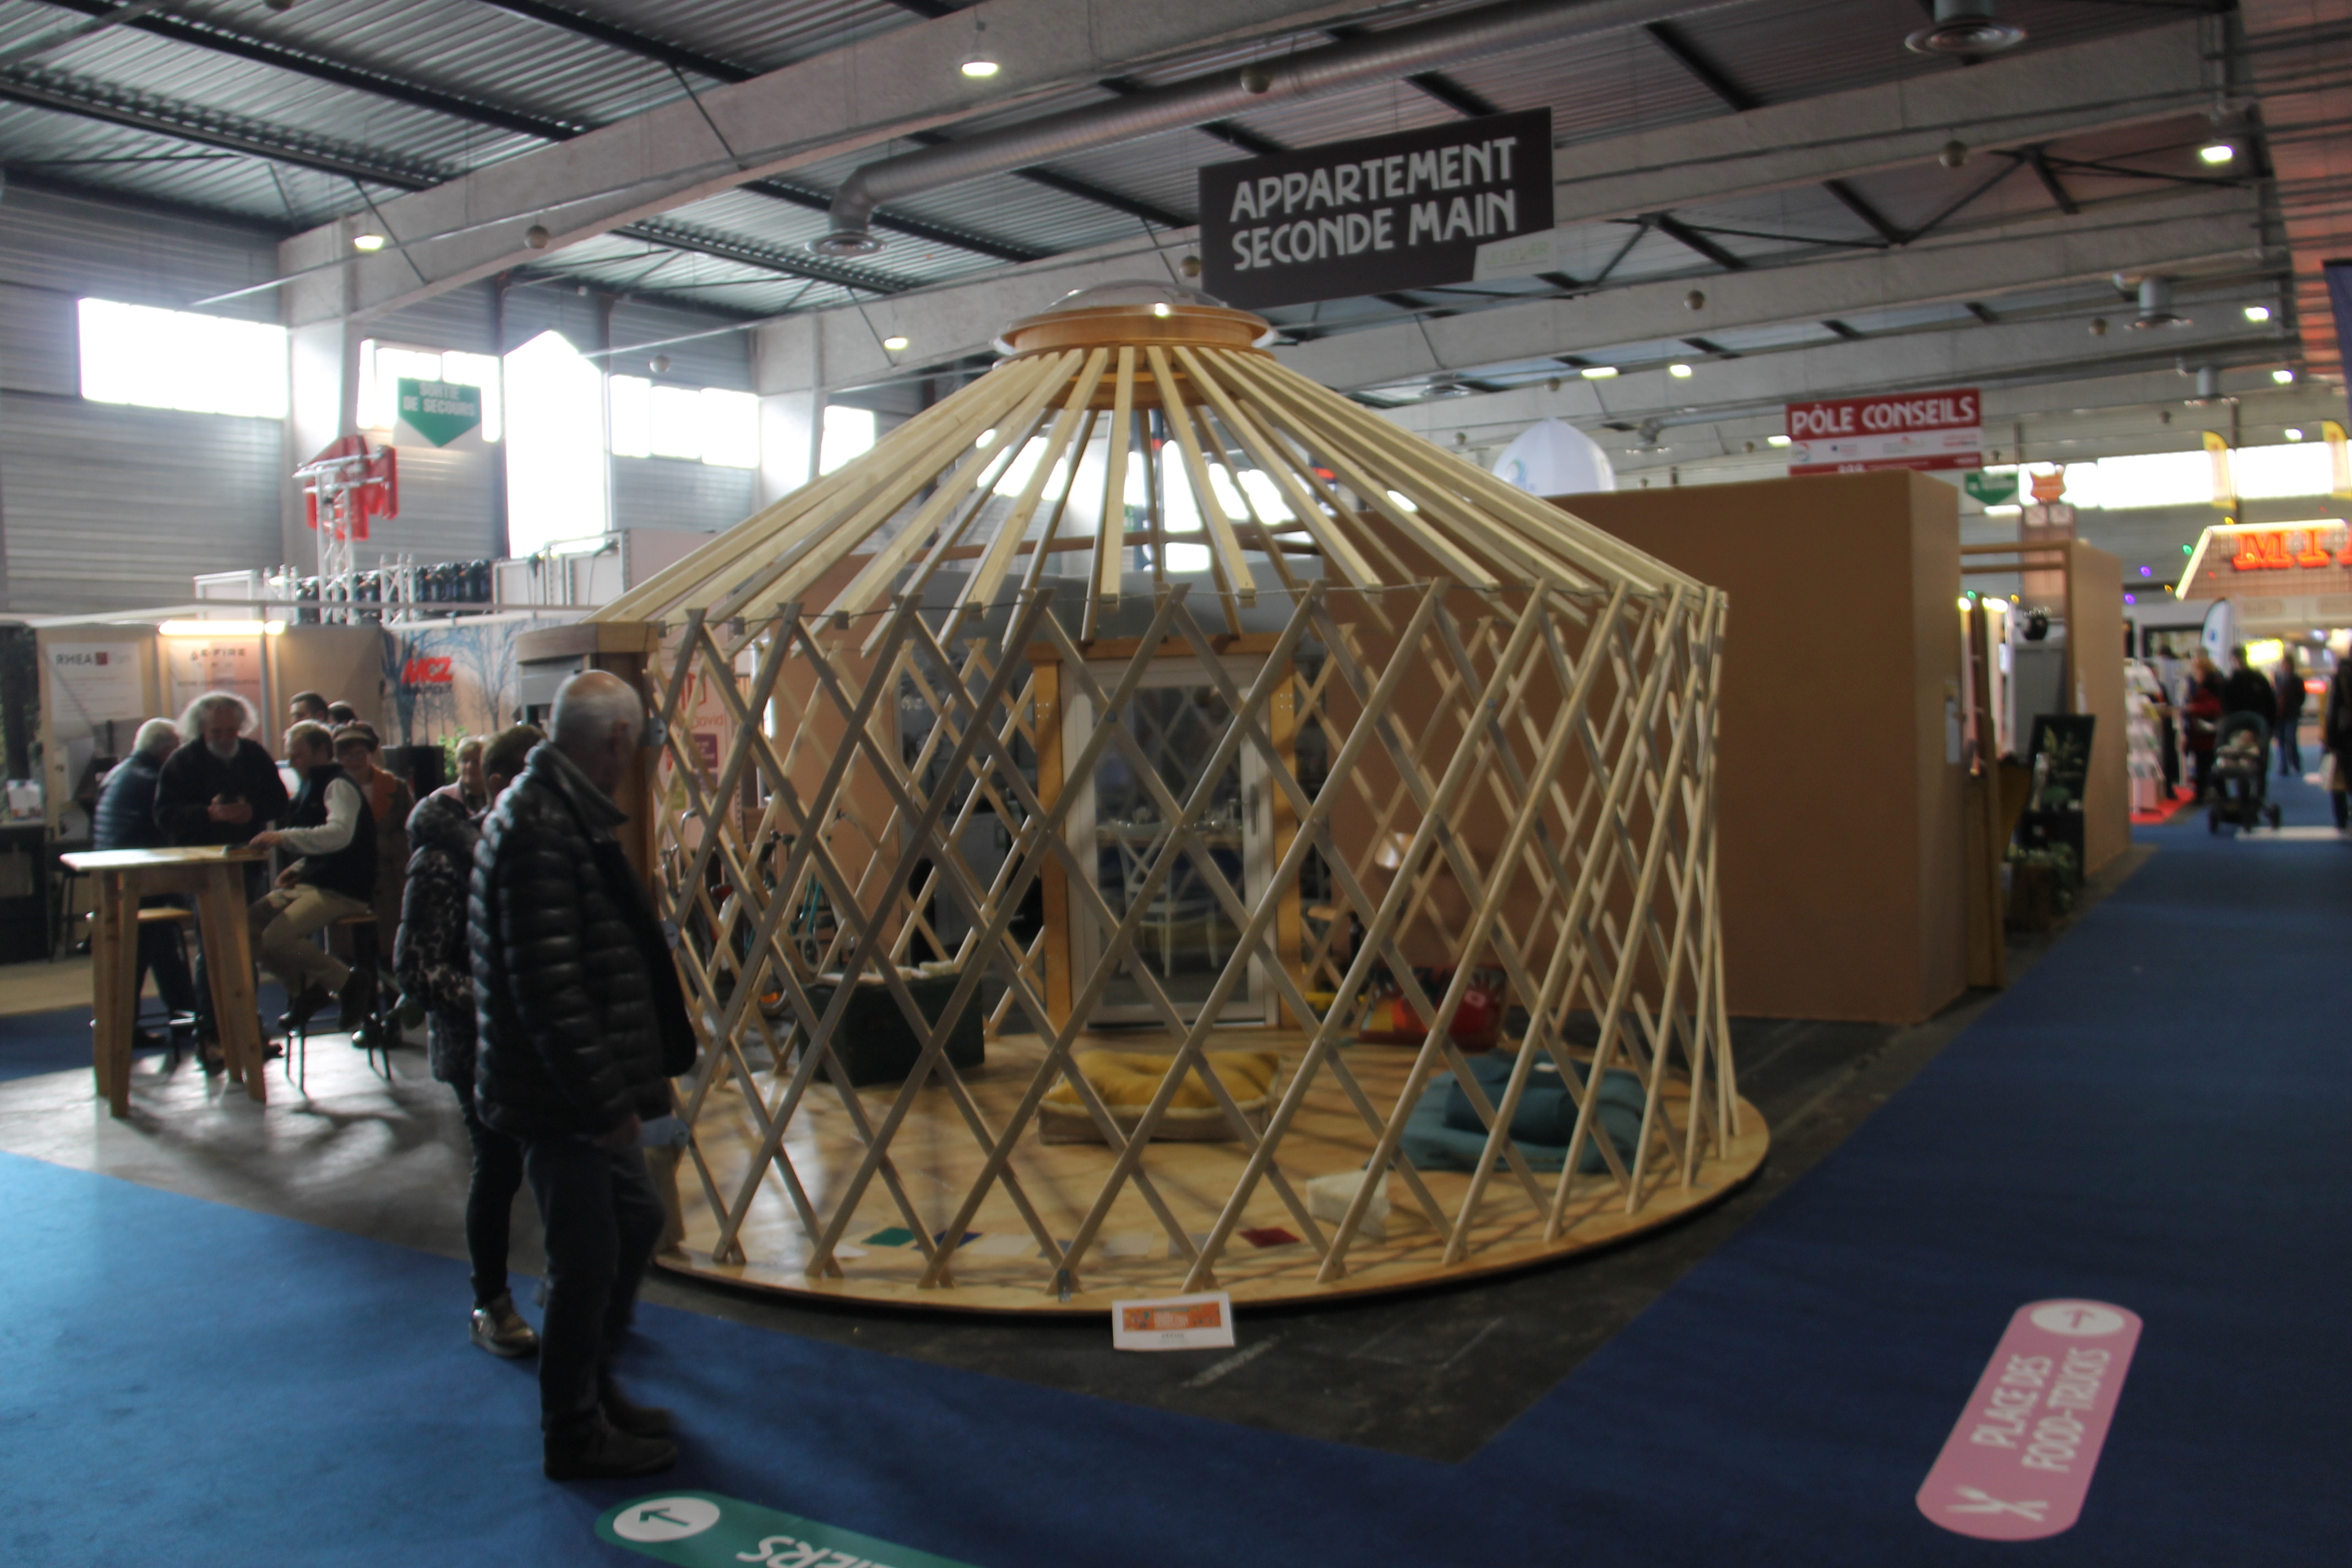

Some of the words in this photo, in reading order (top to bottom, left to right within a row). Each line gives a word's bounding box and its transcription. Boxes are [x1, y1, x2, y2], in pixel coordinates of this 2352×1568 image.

[1229, 137, 1517, 222] APPARTEMENT
[1232, 207, 1394, 271] SECONDE
[1407, 189, 1517, 246] MAIN
[402, 395, 418, 412] DE
[423, 397, 475, 416] SECOURS
[419, 382, 459, 400] SORTIE
[1791, 404, 1855, 435] PÔLE
[1861, 395, 1975, 429] CONSEILS
[2000, 1353, 2054, 1388] DES
[1970, 1386, 2039, 1450] PLACE
[2019, 1346, 2112, 1474] FOOD-TRUCKS
